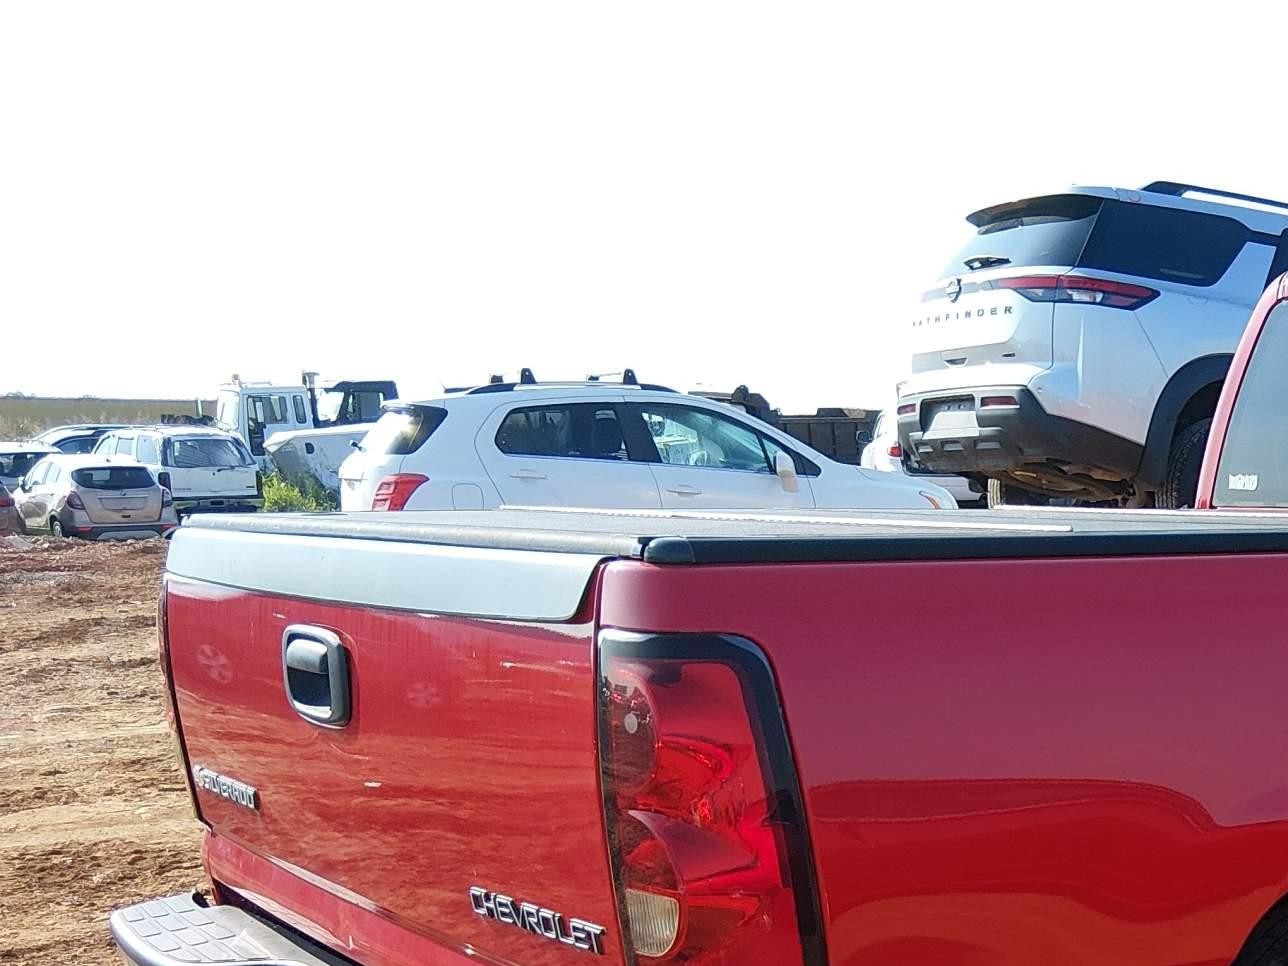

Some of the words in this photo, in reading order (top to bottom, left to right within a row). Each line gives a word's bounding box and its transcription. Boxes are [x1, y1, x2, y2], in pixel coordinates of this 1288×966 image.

[912, 306, 1013, 327] PATHFINDER
[195, 766, 257, 809] SILVERADO
[468, 885, 606, 955] CHEVROLET
